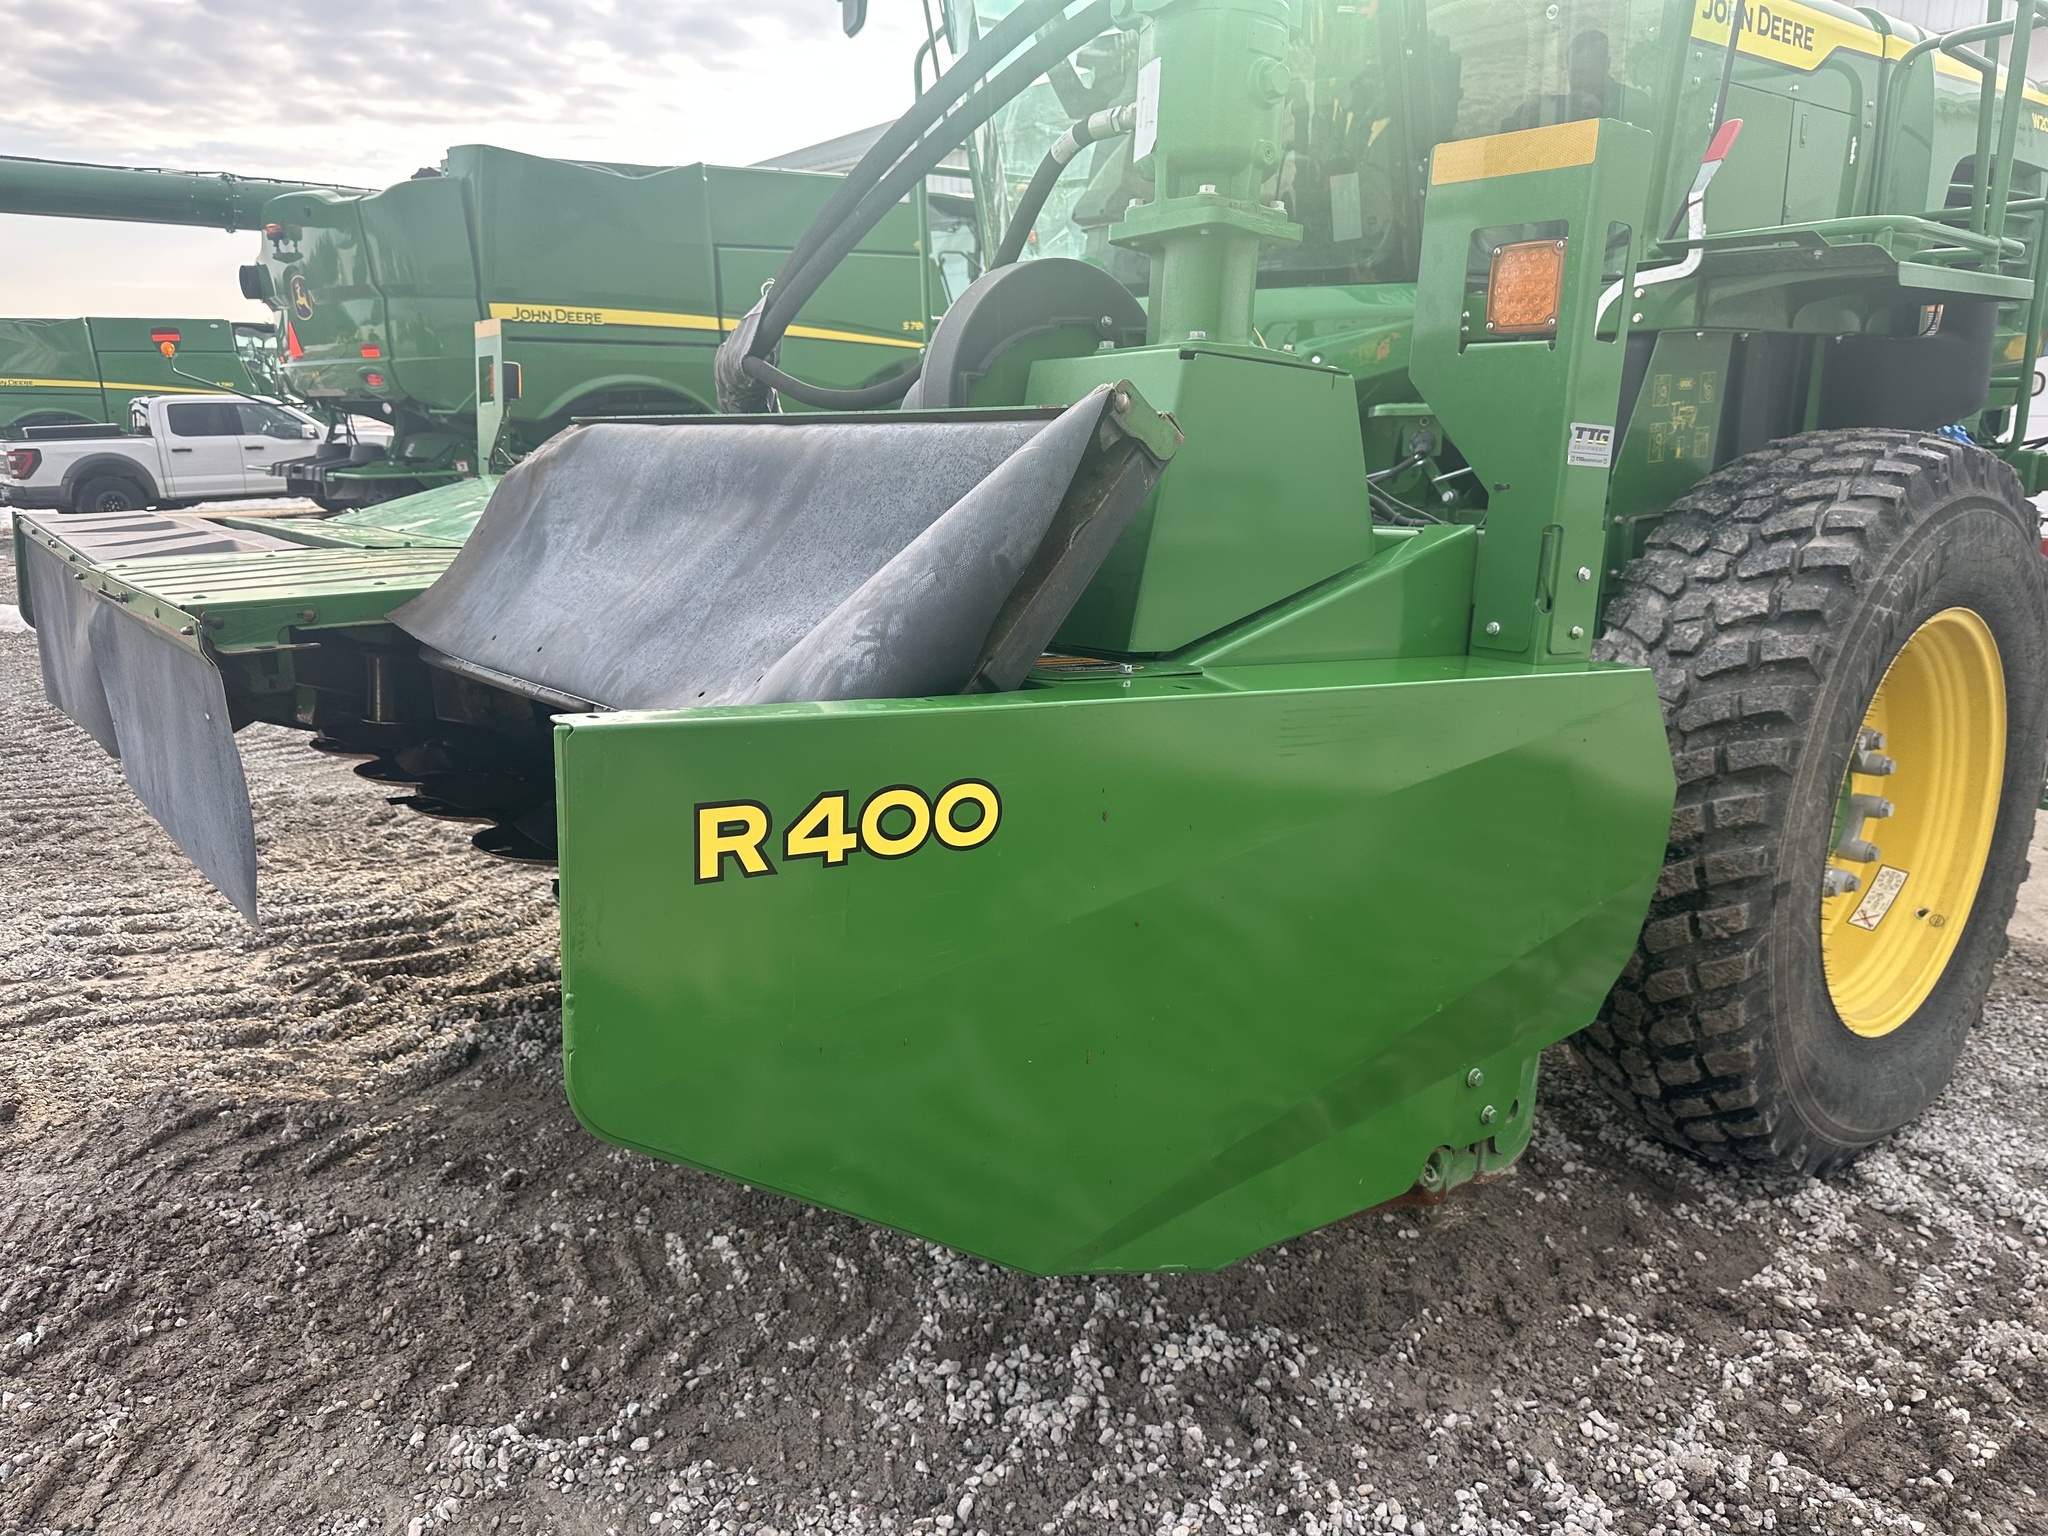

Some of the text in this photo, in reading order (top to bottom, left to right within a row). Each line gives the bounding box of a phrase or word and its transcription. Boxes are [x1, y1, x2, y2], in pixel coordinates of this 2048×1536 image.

[1757, 5, 1815, 51] DEERE
[512, 306, 603, 323] JOHN DEERE
[1575, 426, 1610, 445] TTG
[1573, 444, 1607, 452] EQUIPMENT
